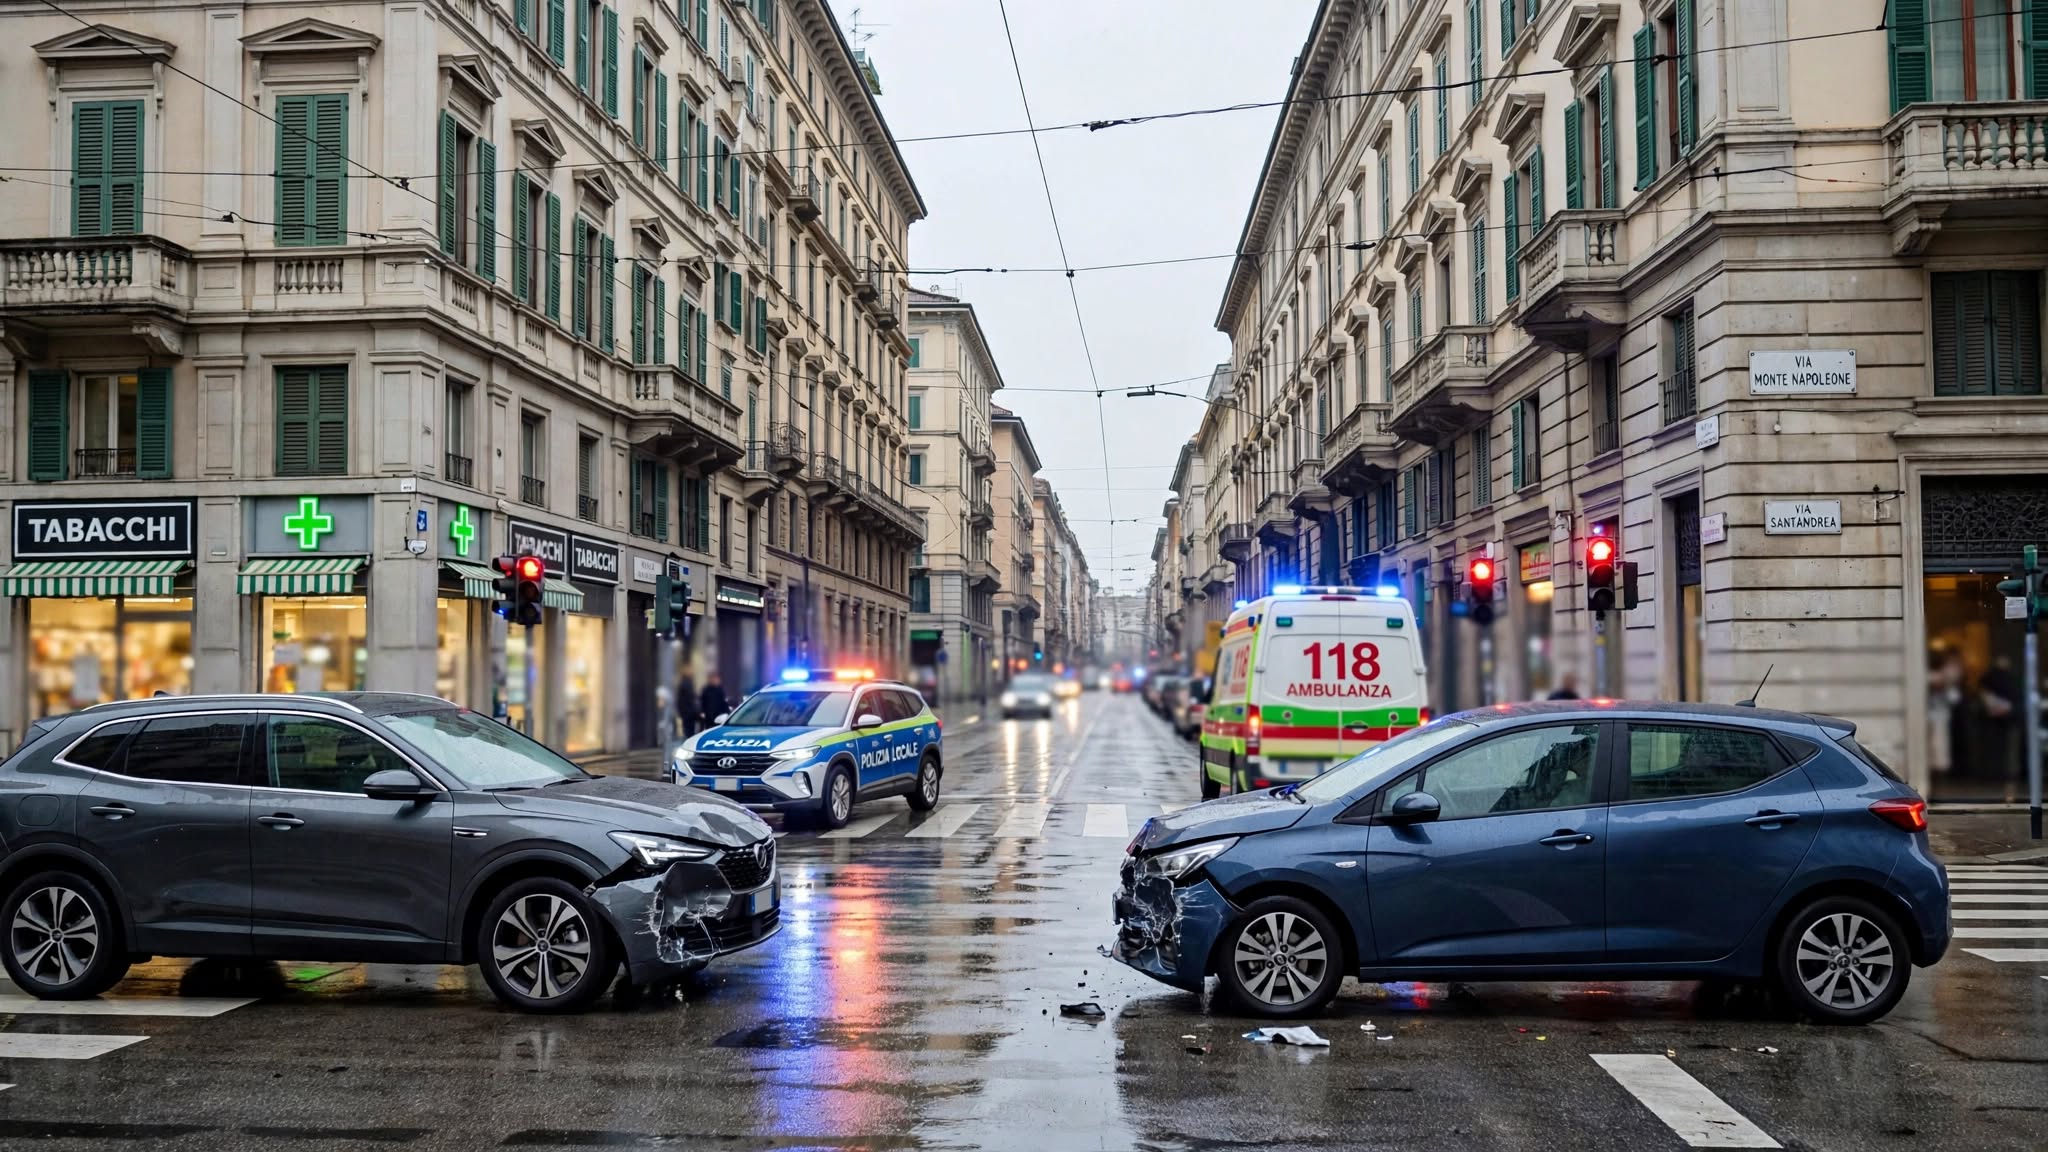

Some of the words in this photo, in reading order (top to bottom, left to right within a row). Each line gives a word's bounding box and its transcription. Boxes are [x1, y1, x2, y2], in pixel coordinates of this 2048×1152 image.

[1795, 355, 1812, 368] VIA
[1754, 373, 1788, 386] MONTE
[1792, 372, 1851, 386] NAPOLEONE
[1795, 504, 1812, 514] VIA
[28, 516, 176, 543] TABACCHI
[575, 547, 617, 573] TABACCHI
[1233, 645, 1250, 679] 118
[1303, 641, 1381, 682] 118
[1286, 683, 1392, 698] AMBULANZA
[702, 738, 771, 750] POLIZIA
[861, 747, 890, 770] POLIZIA
[891, 742, 919, 762] LOCALE
